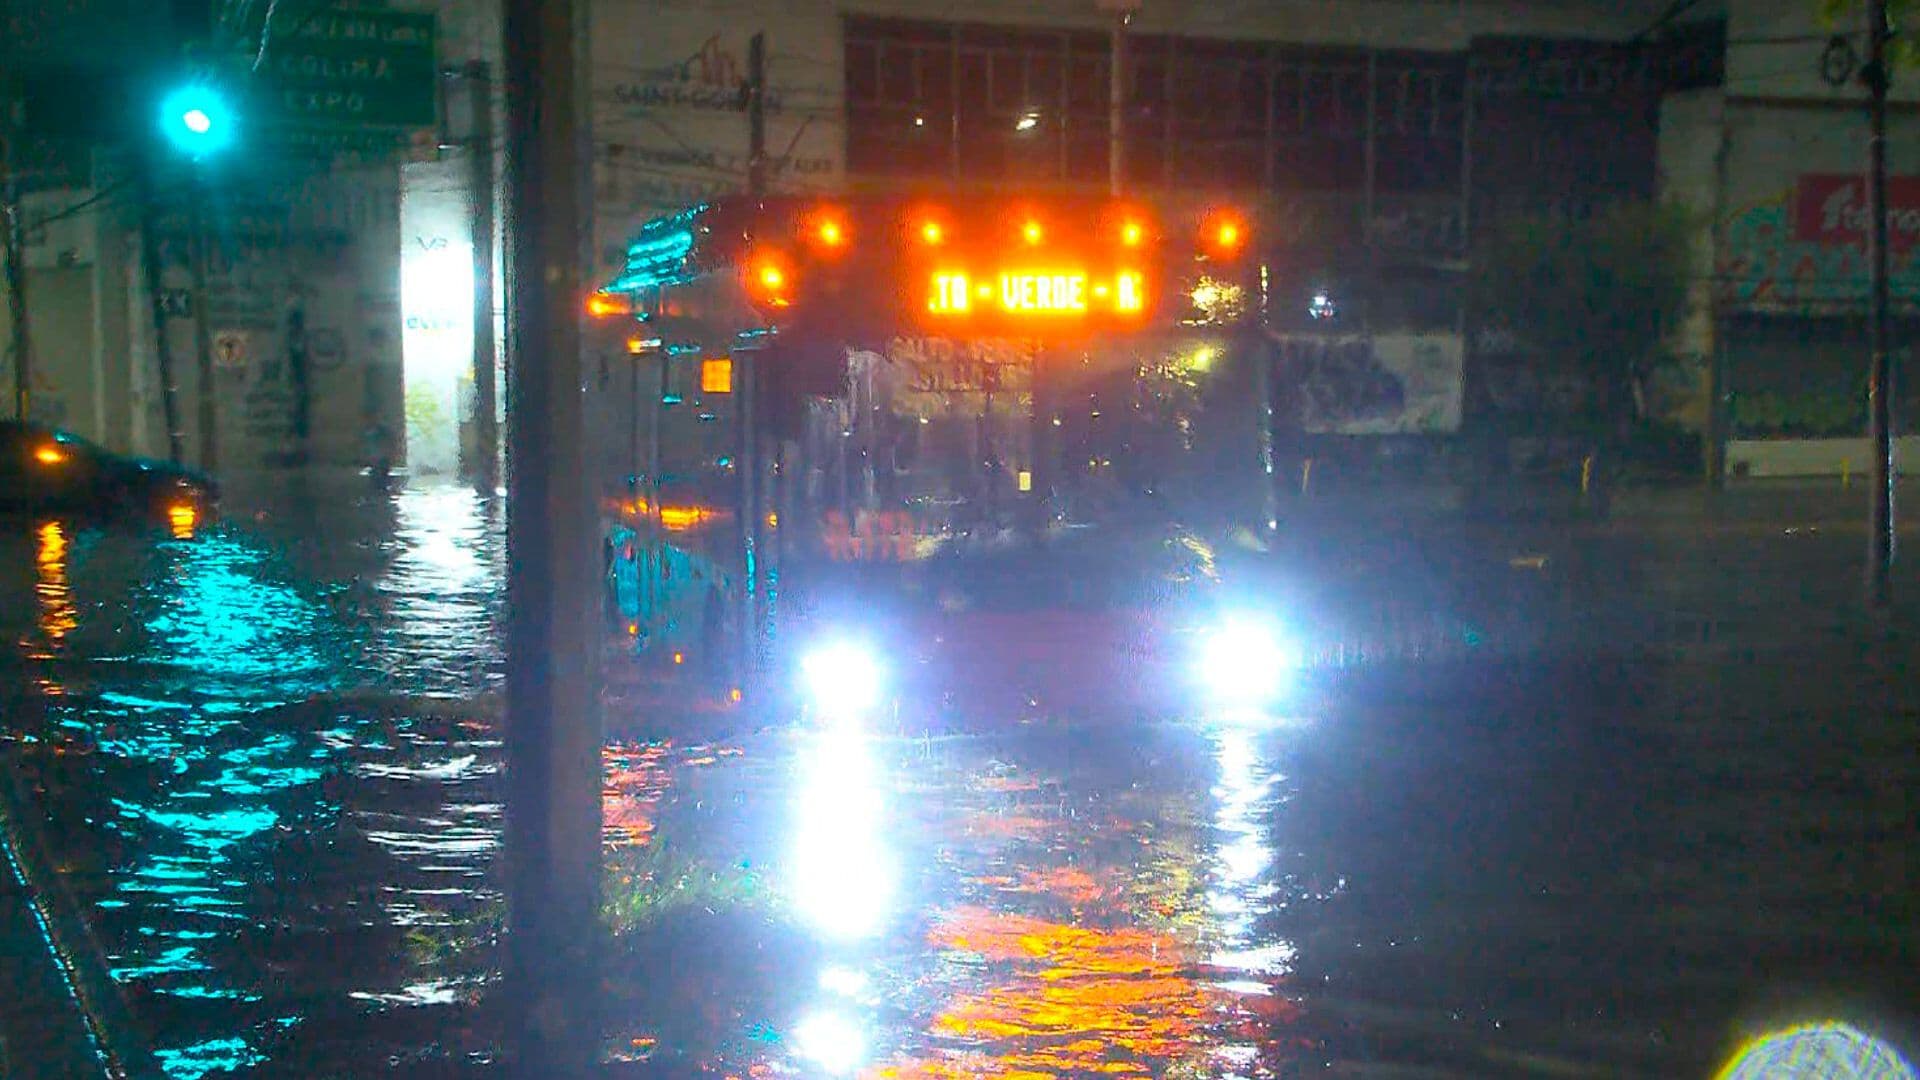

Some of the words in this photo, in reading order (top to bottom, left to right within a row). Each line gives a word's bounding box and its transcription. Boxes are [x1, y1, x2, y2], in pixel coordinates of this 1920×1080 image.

[283, 54, 391, 80] COLIMA
[284, 89, 364, 112] EXPO
[930, 274, 968, 310] TO
[1001, 274, 1086, 311] VERDE
